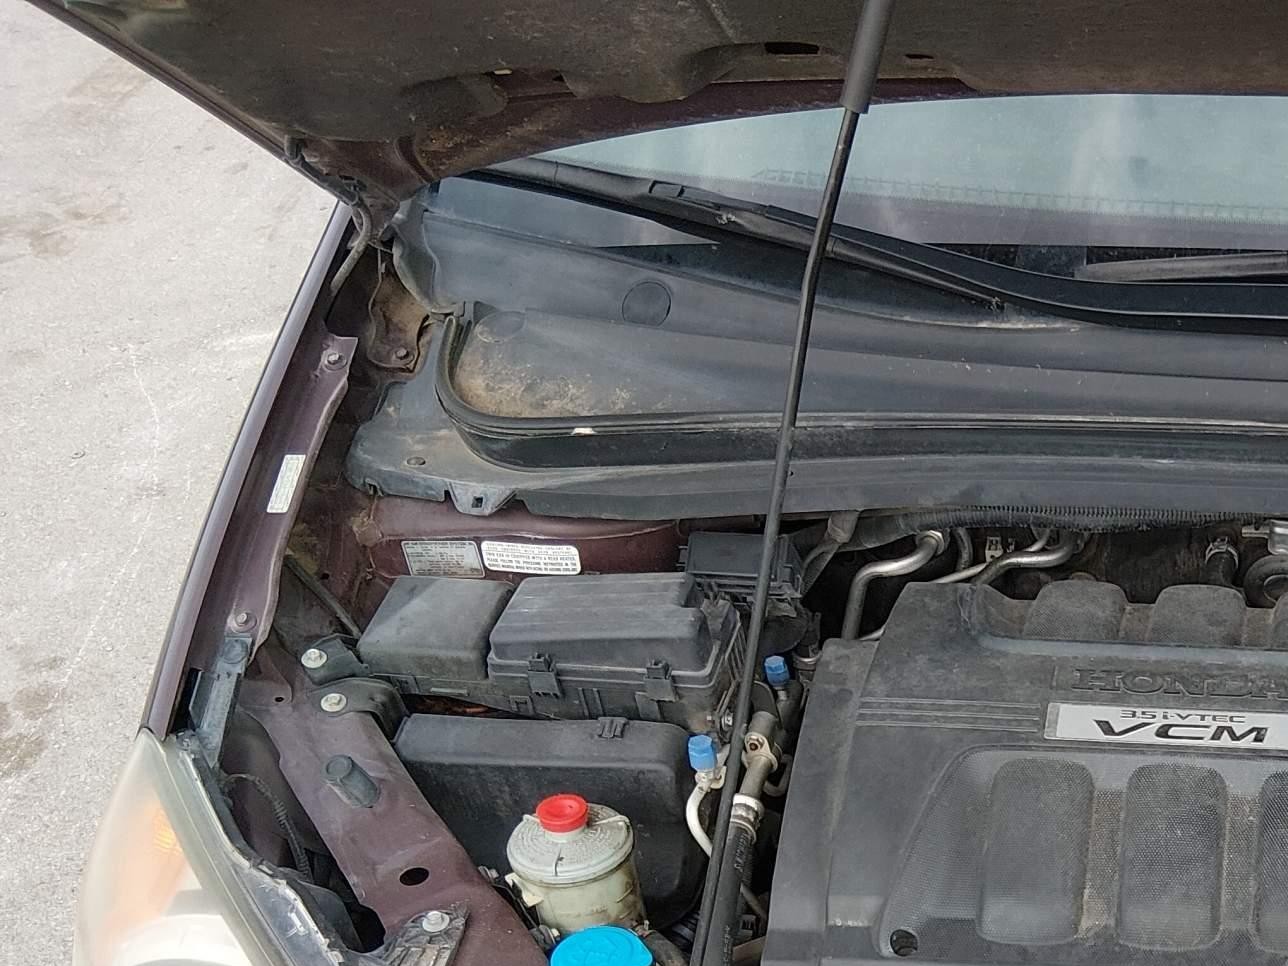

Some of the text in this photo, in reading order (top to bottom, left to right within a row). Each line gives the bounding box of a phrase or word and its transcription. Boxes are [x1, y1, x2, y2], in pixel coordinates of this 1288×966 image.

[1120, 709, 1248, 724] 3.5 i-VTEC
[1093, 719, 1270, 744] VCM
